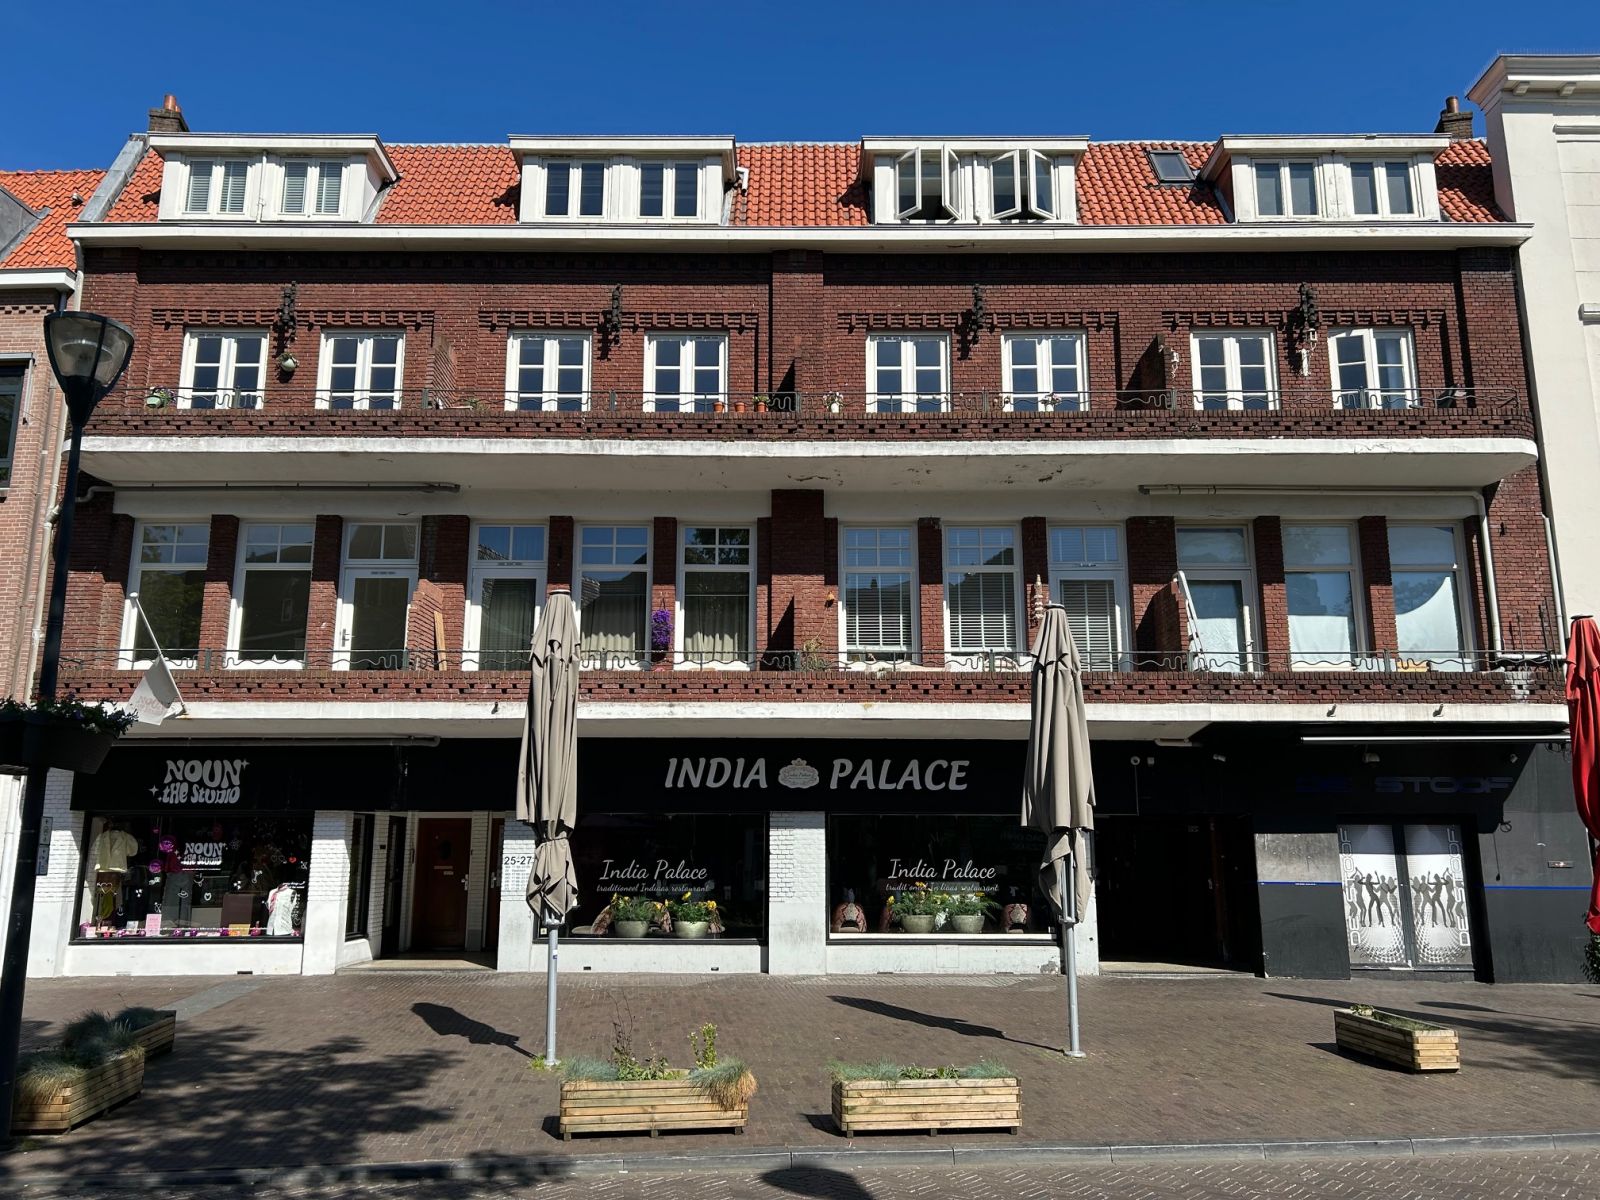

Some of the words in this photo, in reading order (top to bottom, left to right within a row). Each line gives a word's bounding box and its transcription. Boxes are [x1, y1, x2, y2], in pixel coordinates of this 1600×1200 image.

[163, 759, 241, 789] NOUN
[664, 757, 768, 789] INDIA
[829, 758, 970, 791] PALACE
[1374, 776, 1514, 793] STOOF
[184, 842, 223, 858] NOUN
[504, 856, 532, 865] 25-27
[599, 859, 650, 880] India
[653, 859, 708, 880] Palace
[888, 858, 938, 879] India
[942, 858, 997, 880] Palace
